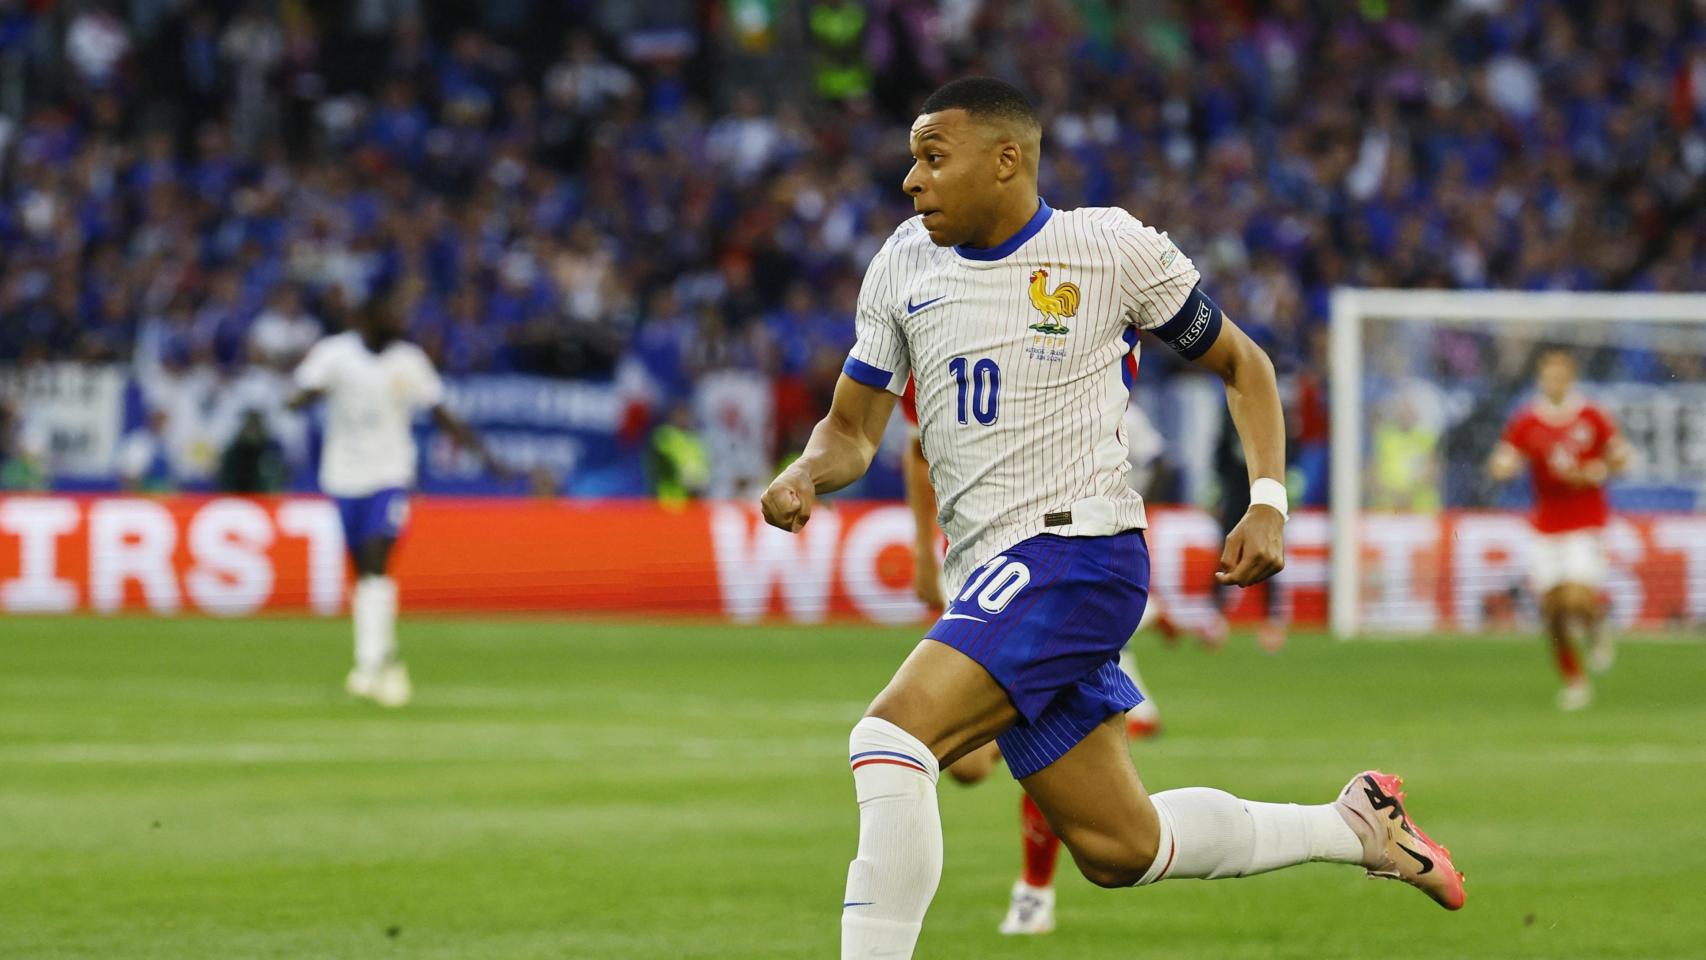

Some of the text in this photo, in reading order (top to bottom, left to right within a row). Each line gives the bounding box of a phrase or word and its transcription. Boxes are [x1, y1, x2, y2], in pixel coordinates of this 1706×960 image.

[1179, 302, 1209, 347] RESPECT
[949, 357, 1000, 426] 10
[959, 555, 1031, 614] 10
